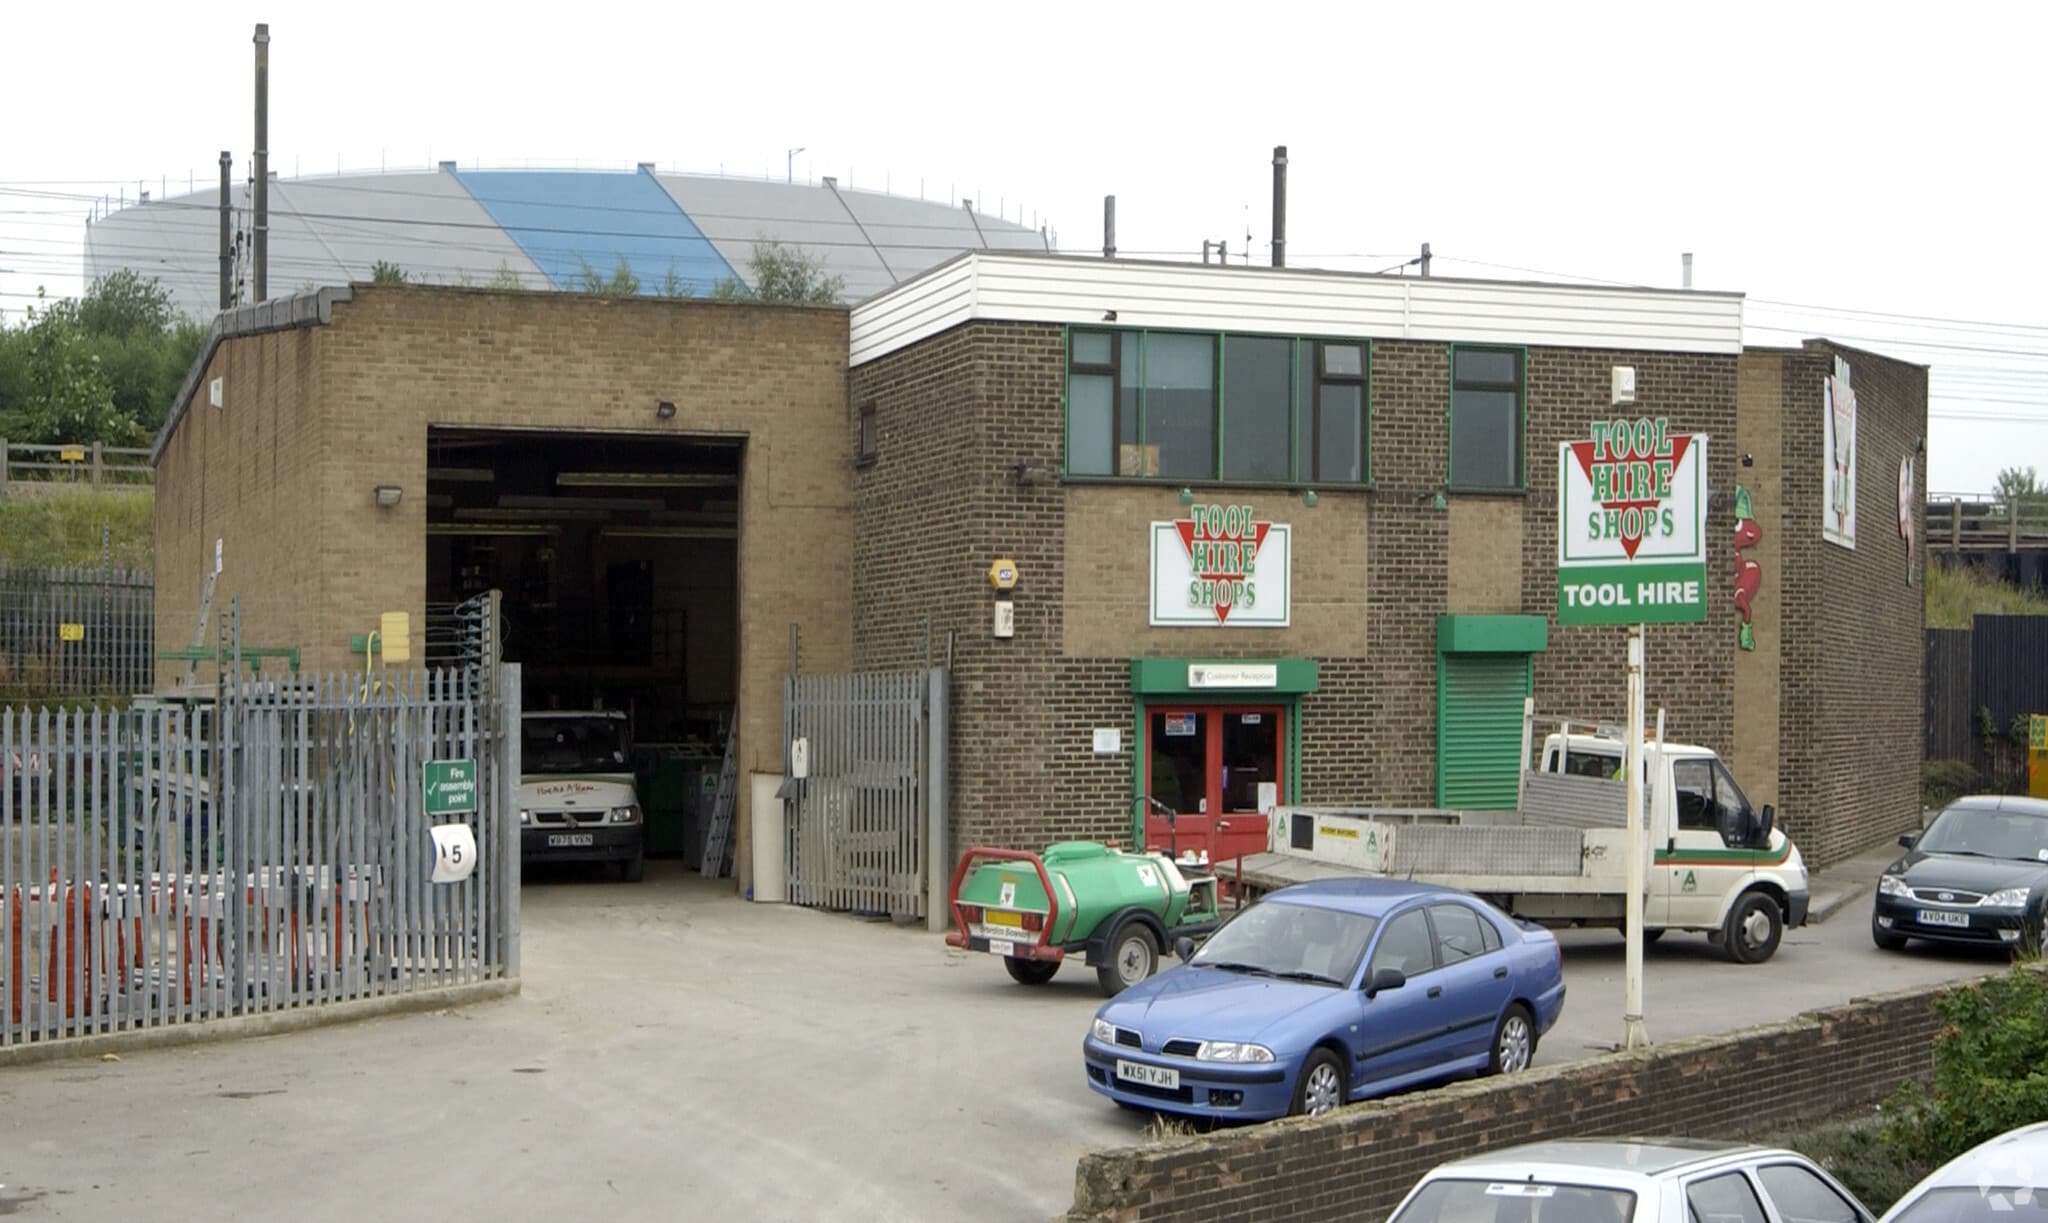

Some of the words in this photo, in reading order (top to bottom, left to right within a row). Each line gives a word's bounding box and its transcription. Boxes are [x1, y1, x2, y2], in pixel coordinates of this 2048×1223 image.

[1591, 417, 1674, 461] TOOL
[1591, 459, 1674, 502] HIRE
[1192, 504, 1257, 539] TOOL
[1588, 507, 1674, 541] SHOPS
[1192, 540, 1256, 574] HIRE
[1189, 579, 1256, 607] SHOPS
[1563, 583, 1632, 607] TOOL
[1637, 581, 1700, 604] HIRE
[439, 781, 474, 793] assembly
[450, 767, 464, 779] Fire
[448, 794, 468, 806] point
[1122, 1063, 1147, 1081] WX51
[1150, 1068, 1173, 1086] YJH
